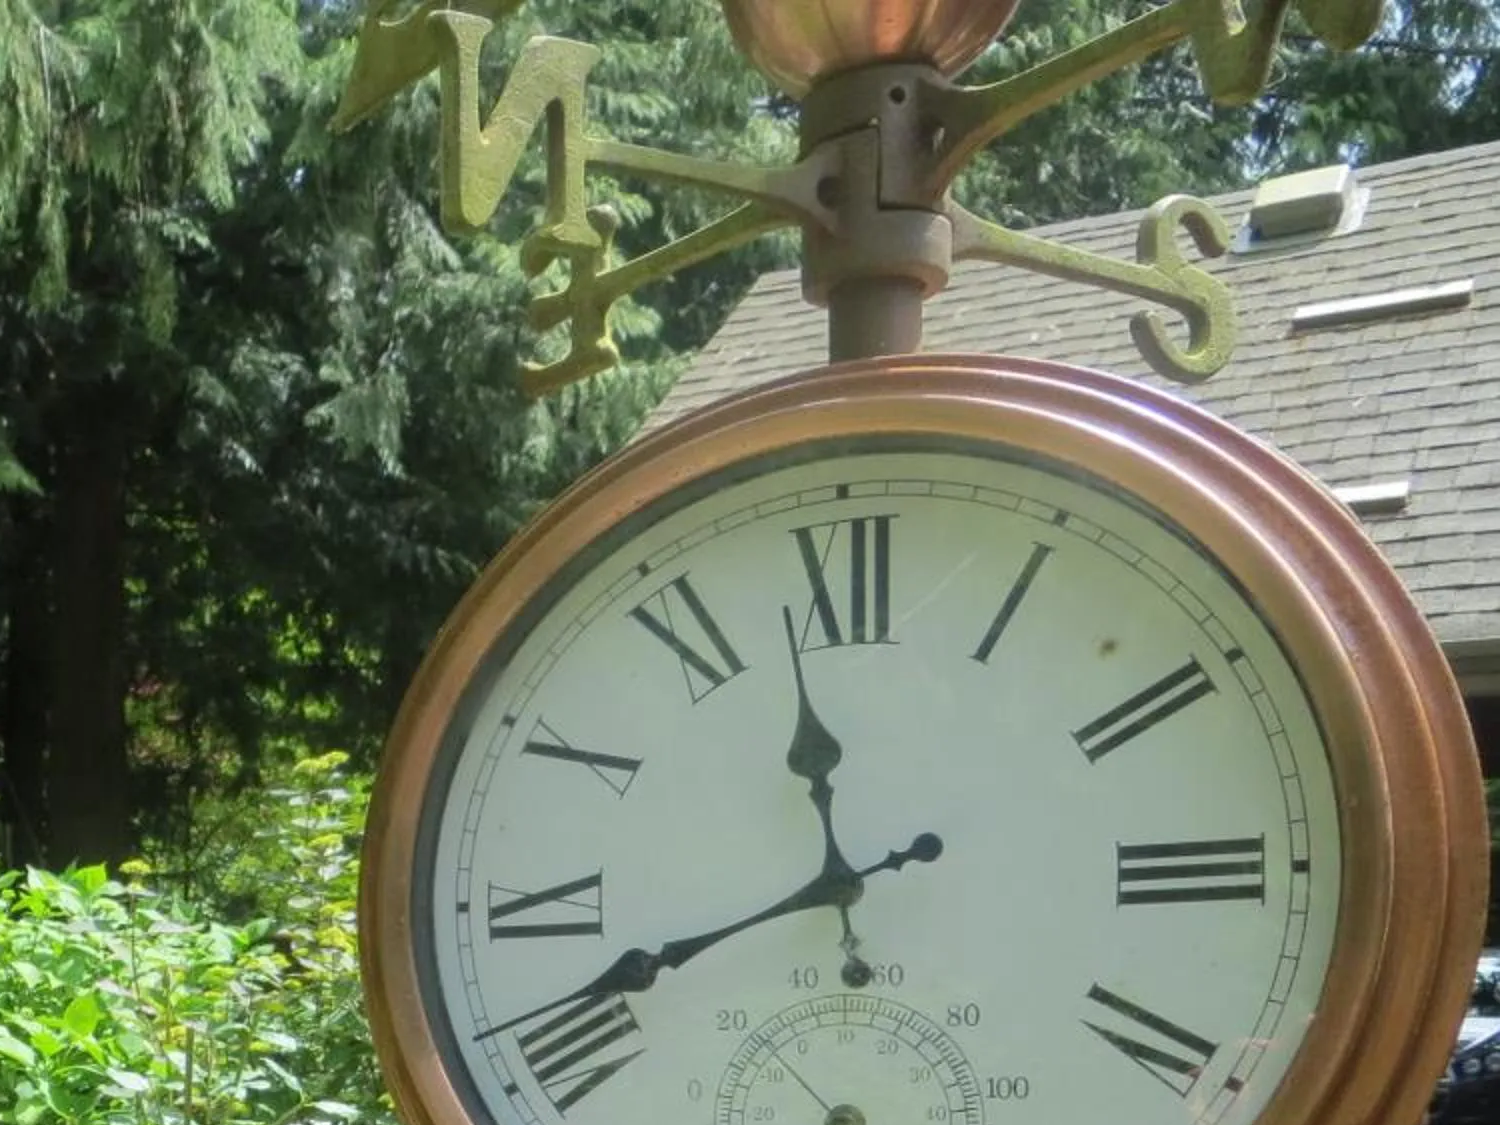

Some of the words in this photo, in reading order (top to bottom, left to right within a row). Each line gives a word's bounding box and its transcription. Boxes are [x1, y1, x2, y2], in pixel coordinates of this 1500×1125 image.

[788, 513, 901, 654] XII
[625, 570, 750, 705] XI
[1068, 653, 1219, 765] II
[520, 715, 644, 799] X
[486, 866, 604, 944] IX
[1115, 832, 1265, 909] III
[787, 966, 820, 989] 40
[872, 963, 904, 987] 60
[715, 1009, 748, 1032] 20
[947, 1002, 981, 1027] 80
[1078, 982, 1221, 1099] IV
[687, 1079, 703, 1101] 0
[986, 1076, 1030, 1100] 100
